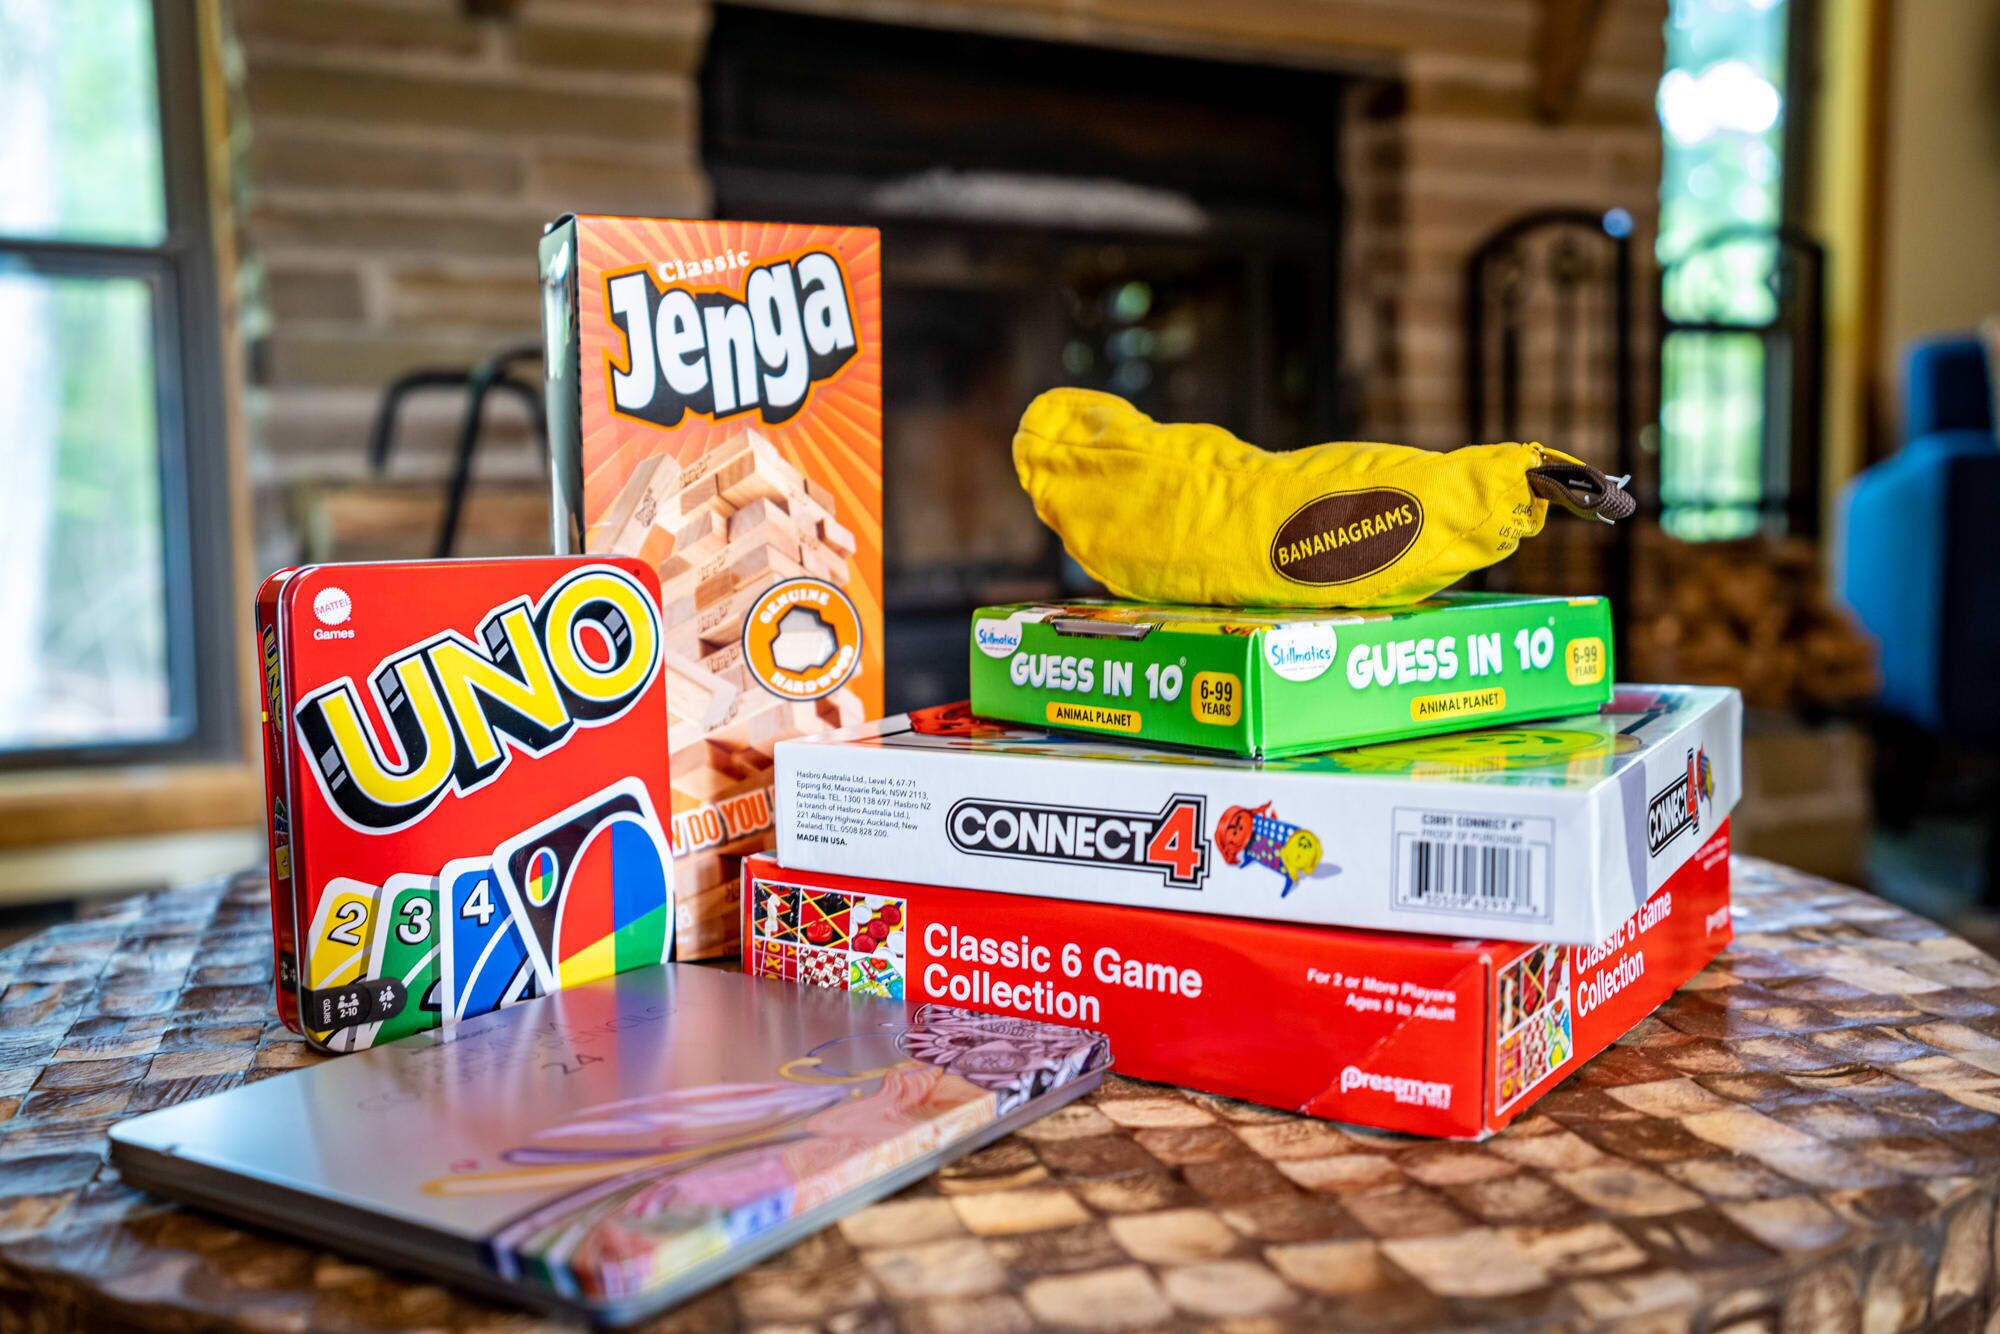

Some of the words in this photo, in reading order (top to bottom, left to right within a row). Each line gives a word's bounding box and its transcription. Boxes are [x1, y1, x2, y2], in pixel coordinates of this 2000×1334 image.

[657, 248, 751, 284] Classic
[608, 250, 857, 416] Jenga
[1278, 503, 1415, 568] BANANAGRAMS
[316, 597, 349, 614] MATTEL
[759, 588, 830, 624] GENUINE
[313, 628, 356, 641] Games
[1346, 637, 1459, 690] GUESS
[1467, 632, 1503, 677] IN
[1572, 645, 1599, 666] 6-99
[1574, 663, 1598, 677] YEARS
[1010, 652, 1094, 694] GUESS
[1103, 659, 1133, 697] IN
[1200, 679, 1233, 702] 6-99
[300, 566, 659, 828] UNO
[1201, 701, 1231, 717] YEARS
[1418, 699, 1460, 716] ANIMAL
[1463, 693, 1500, 711] PLANET
[1056, 708, 1094, 723] ANIMAL
[1096, 711, 1133, 728] PLANET
[797, 771, 820, 779] Hasbro
[822, 773, 850, 782] Australia
[869, 777, 887, 785] Level
[797, 782, 820, 791] Epping
[835, 785, 870, 795] Macquarie
[889, 790, 907, 798] NSW
[687, 809, 720, 846] DO
[721, 792, 769, 835] YOU
[805, 802, 827, 810] branch
[828, 803, 836, 811] of
[837, 804, 860, 814] Hasbro
[862, 807, 892, 817] Australia
[844, 795, 861, 804] 1300
[863, 796, 876, 805] 138
[894, 800, 919, 809] Hasbro
[920, 802, 932, 810] NZ
[1649, 783, 1690, 849] CONNECT
[1687, 758, 1697, 825] 4
[797, 811, 809, 819] 221
[811, 812, 833, 822] Albany
[902, 822, 918, 831] New
[859, 827, 872, 835] 828
[796, 833, 819, 843] MADE
[821, 835, 828, 843] IN
[830, 837, 848, 846] USA.
[954, 806, 1154, 863] CONNECT
[1147, 802, 1199, 879] 4
[460, 878, 496, 927] 4
[1637, 891, 1672, 934] Game
[327, 900, 368, 946] 2
[399, 896, 434, 946] 3
[923, 922, 1051, 974] Classic
[1060, 943, 1082, 978] 6
[1092, 946, 1204, 998] Game
[923, 962, 1101, 1023] Collection
[1306, 967, 1331, 984] For
[1333, 971, 1343, 987] 2
[1344, 976, 1361, 989] or
[1362, 976, 1399, 996] More
[1401, 981, 1456, 1004] Players
[1577, 950, 1645, 1018] Collection
[340, 1006, 358, 1019] 2-10
[381, 1001, 393, 1012] 7+
[1345, 992, 1382, 1013] Ages
[1396, 1001, 1412, 1016] to
[1414, 1003, 1456, 1022] Adult
